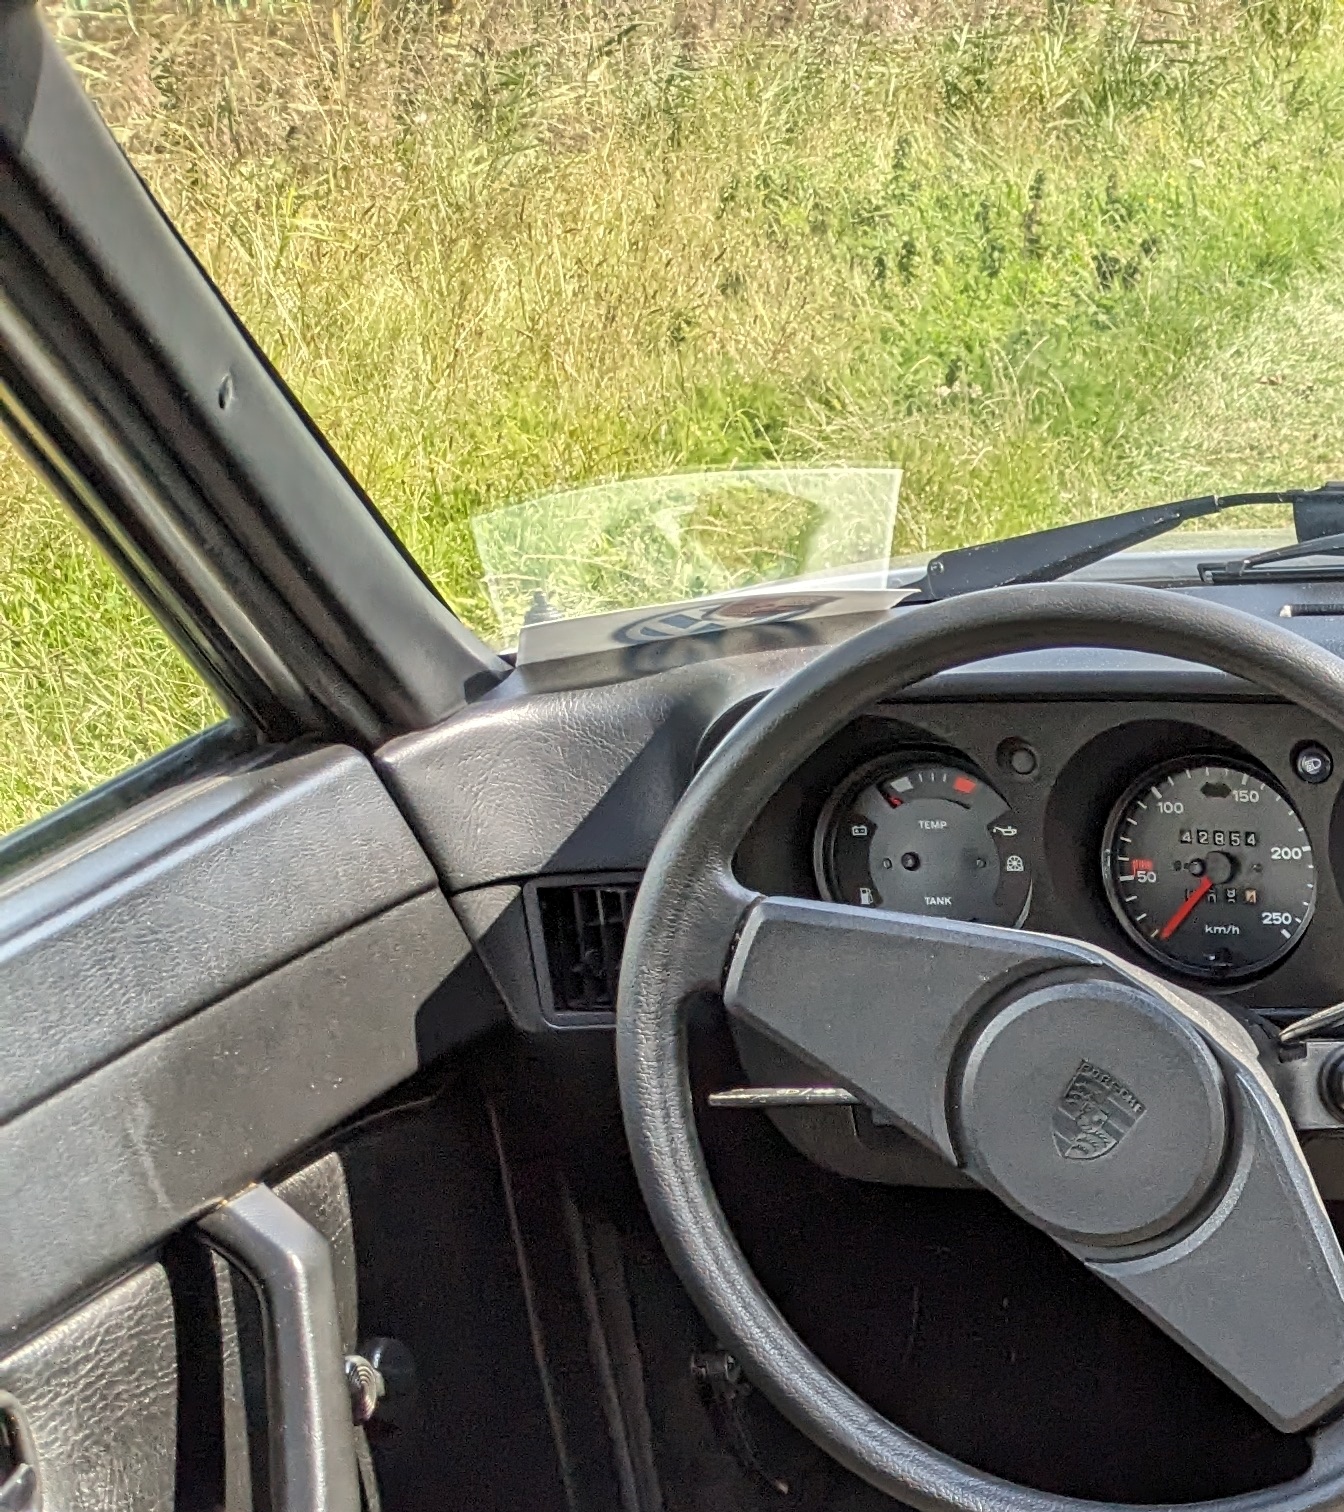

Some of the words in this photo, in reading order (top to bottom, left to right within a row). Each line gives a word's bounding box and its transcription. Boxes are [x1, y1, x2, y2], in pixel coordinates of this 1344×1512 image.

[1232, 790, 1260, 803] 150
[1156, 801, 1184, 814] 100
[918, 820, 948, 830] TEMP
[1270, 847, 1302, 860] 200
[1137, 871, 1157, 883] 50
[924, 896, 952, 906] TANK
[1261, 912, 1292, 925] 250
[1205, 924, 1240, 935] km/h
